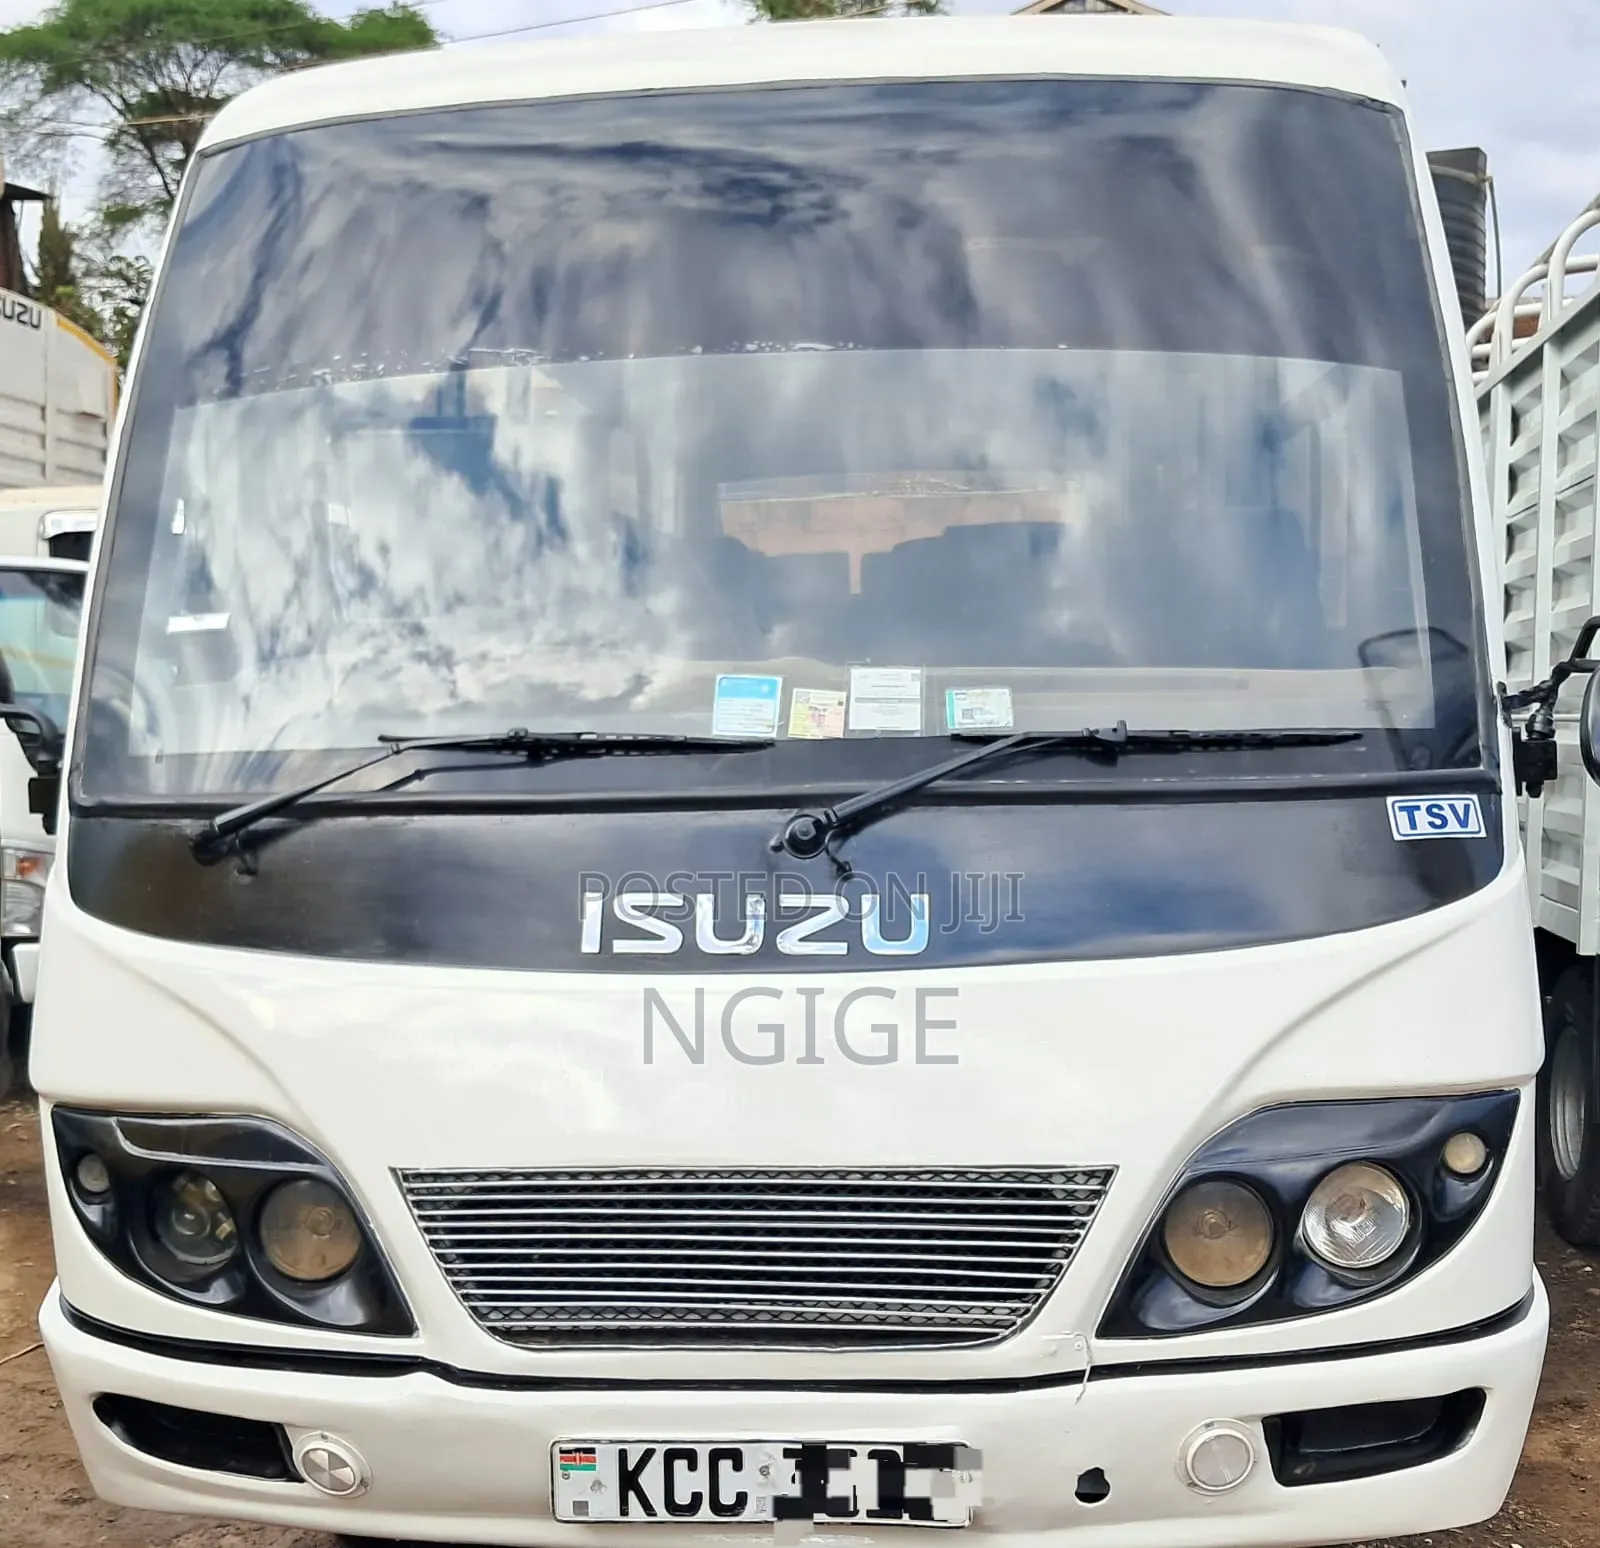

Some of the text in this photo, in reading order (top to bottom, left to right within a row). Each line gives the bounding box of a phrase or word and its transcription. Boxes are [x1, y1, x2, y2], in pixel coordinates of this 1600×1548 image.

[0, 296, 42, 329] UZU
[1397, 803, 1471, 831] TSV
[580, 891, 931, 956] ISUZU
[618, 1446, 749, 1518] KCC
